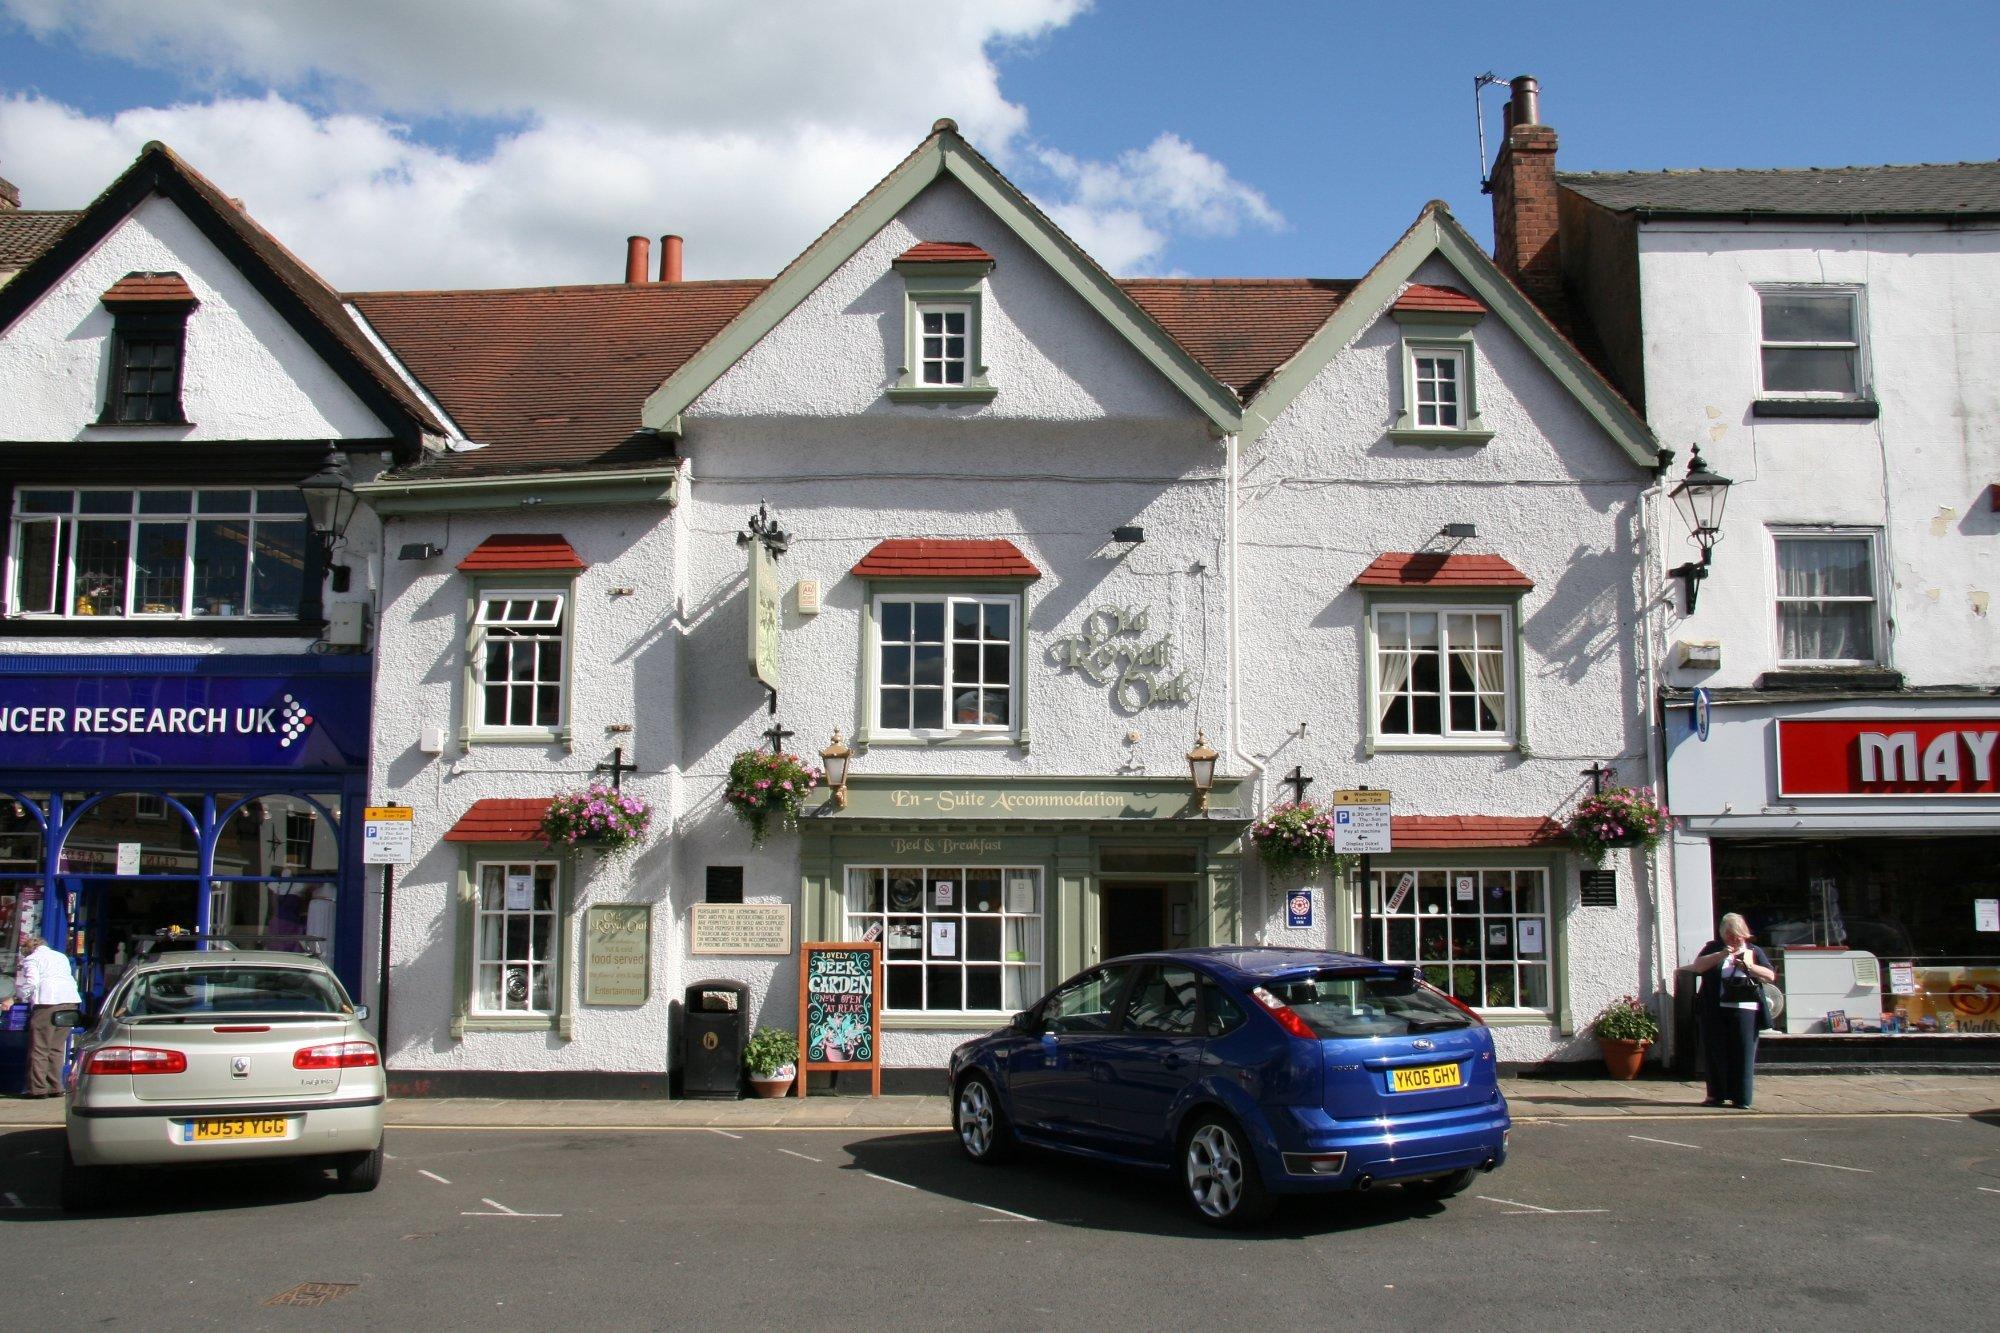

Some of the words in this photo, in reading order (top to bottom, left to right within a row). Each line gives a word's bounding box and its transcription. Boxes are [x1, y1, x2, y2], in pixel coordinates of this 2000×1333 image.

[1091, 604, 1153, 636] Old
[1050, 633, 1174, 684] Royal
[1118, 668, 1194, 708] Oak
[73, 708, 226, 733] RESEARCH
[236, 708, 277, 733] UK
[1860, 730, 2000, 782] MAY
[891, 790, 919, 807] En
[937, 790, 985, 811] Suite
[990, 790, 1124, 811] Accommodation
[891, 838, 920, 853] Bed
[924, 838, 935, 852] &
[938, 838, 1001, 855] Breakfast
[1389, 877, 1411, 909] VACANCIES
[592, 920, 625, 934] Royal
[592, 953, 611, 964] food
[614, 953, 644, 964] served
[817, 960, 859, 975] BEER
[595, 986, 642, 996] Entertainment
[808, 975, 872, 994] GARDEN
[841, 994, 862, 1003] OPEN
[825, 1004, 835, 1013] AT
[1395, 1069, 1430, 1087] YK06
[1433, 1066, 1457, 1084] GHY
[198, 1120, 245, 1136] MJ53
[251, 1118, 284, 1134] YGG
